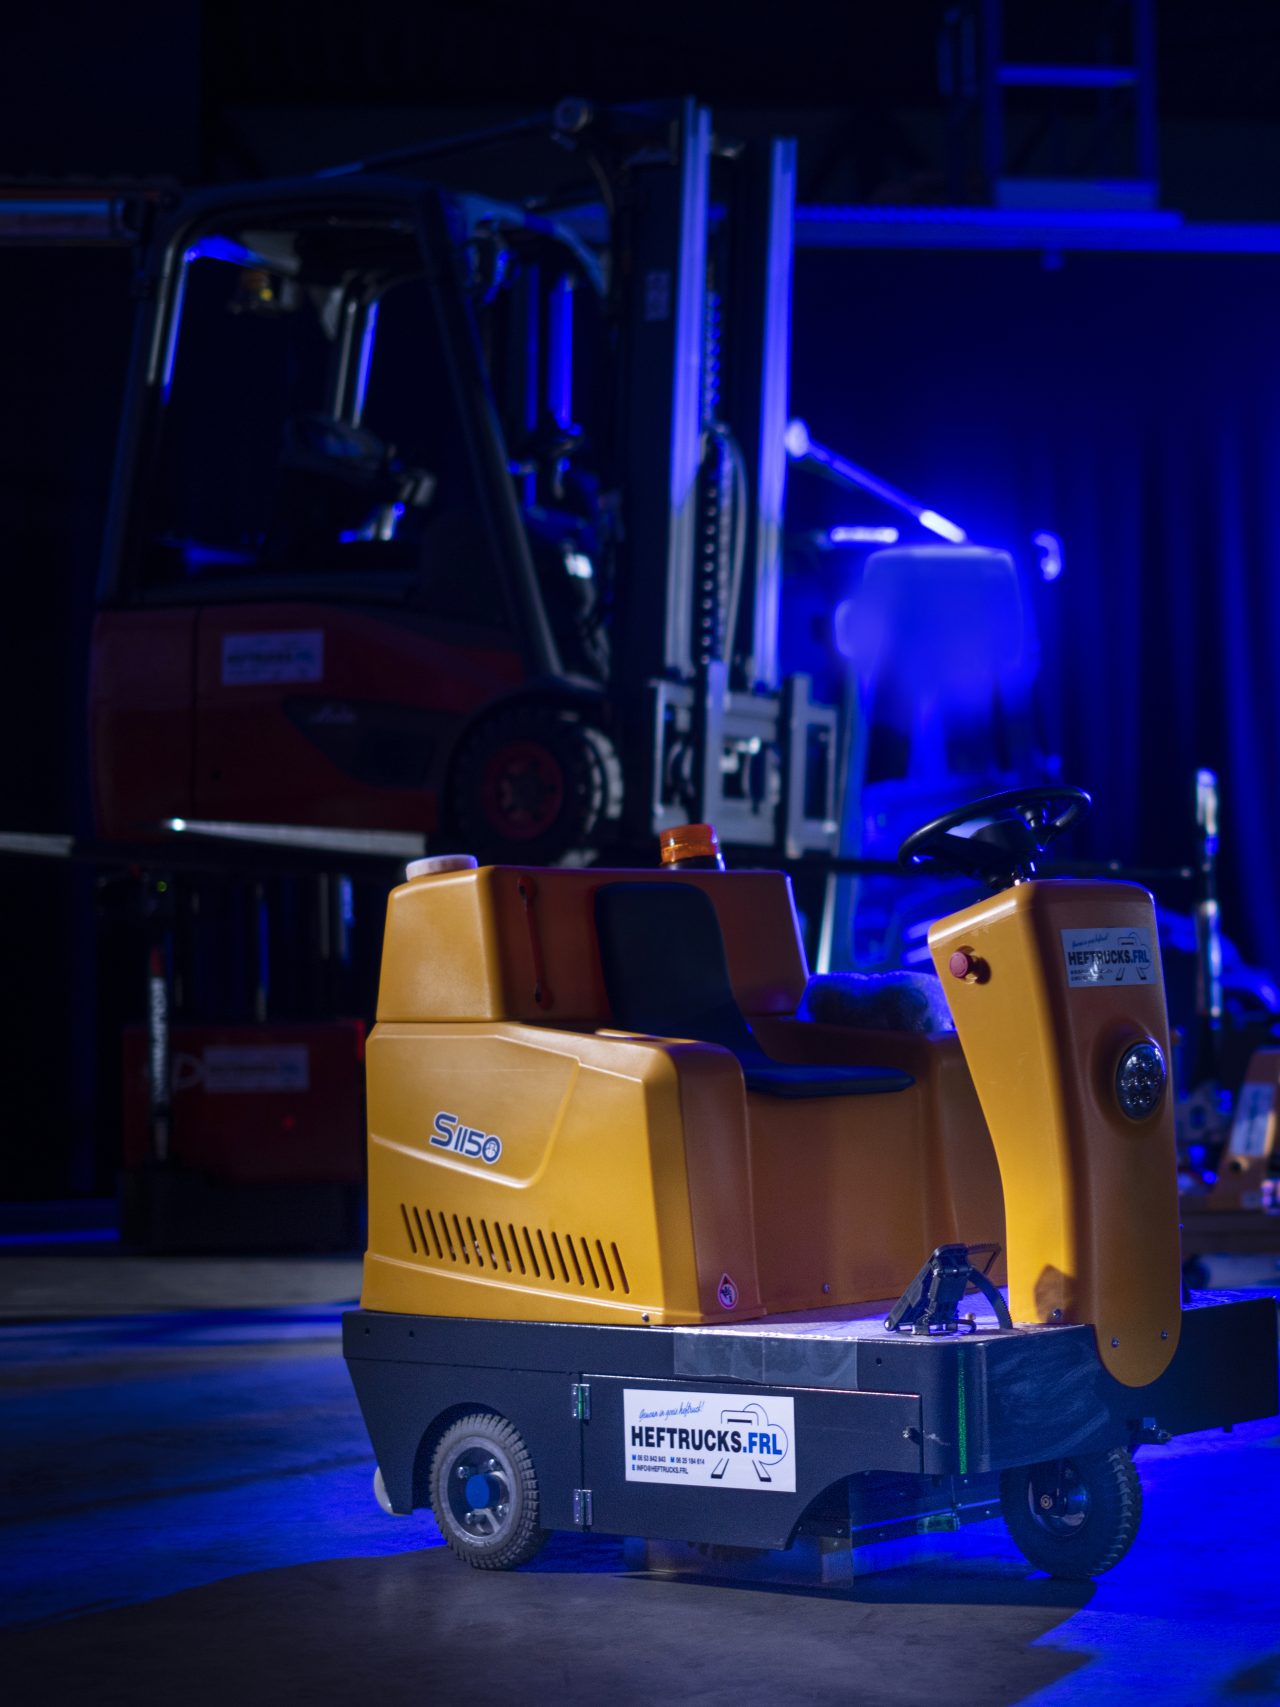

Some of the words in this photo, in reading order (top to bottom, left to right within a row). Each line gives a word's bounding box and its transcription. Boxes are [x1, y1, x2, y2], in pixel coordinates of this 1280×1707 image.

[1068, 949, 1150, 966] HEFTRUCKS.FRL
[429, 1111, 502, 1165] S1150
[631, 1425, 783, 1455] HEFTRUCKS.FRL
